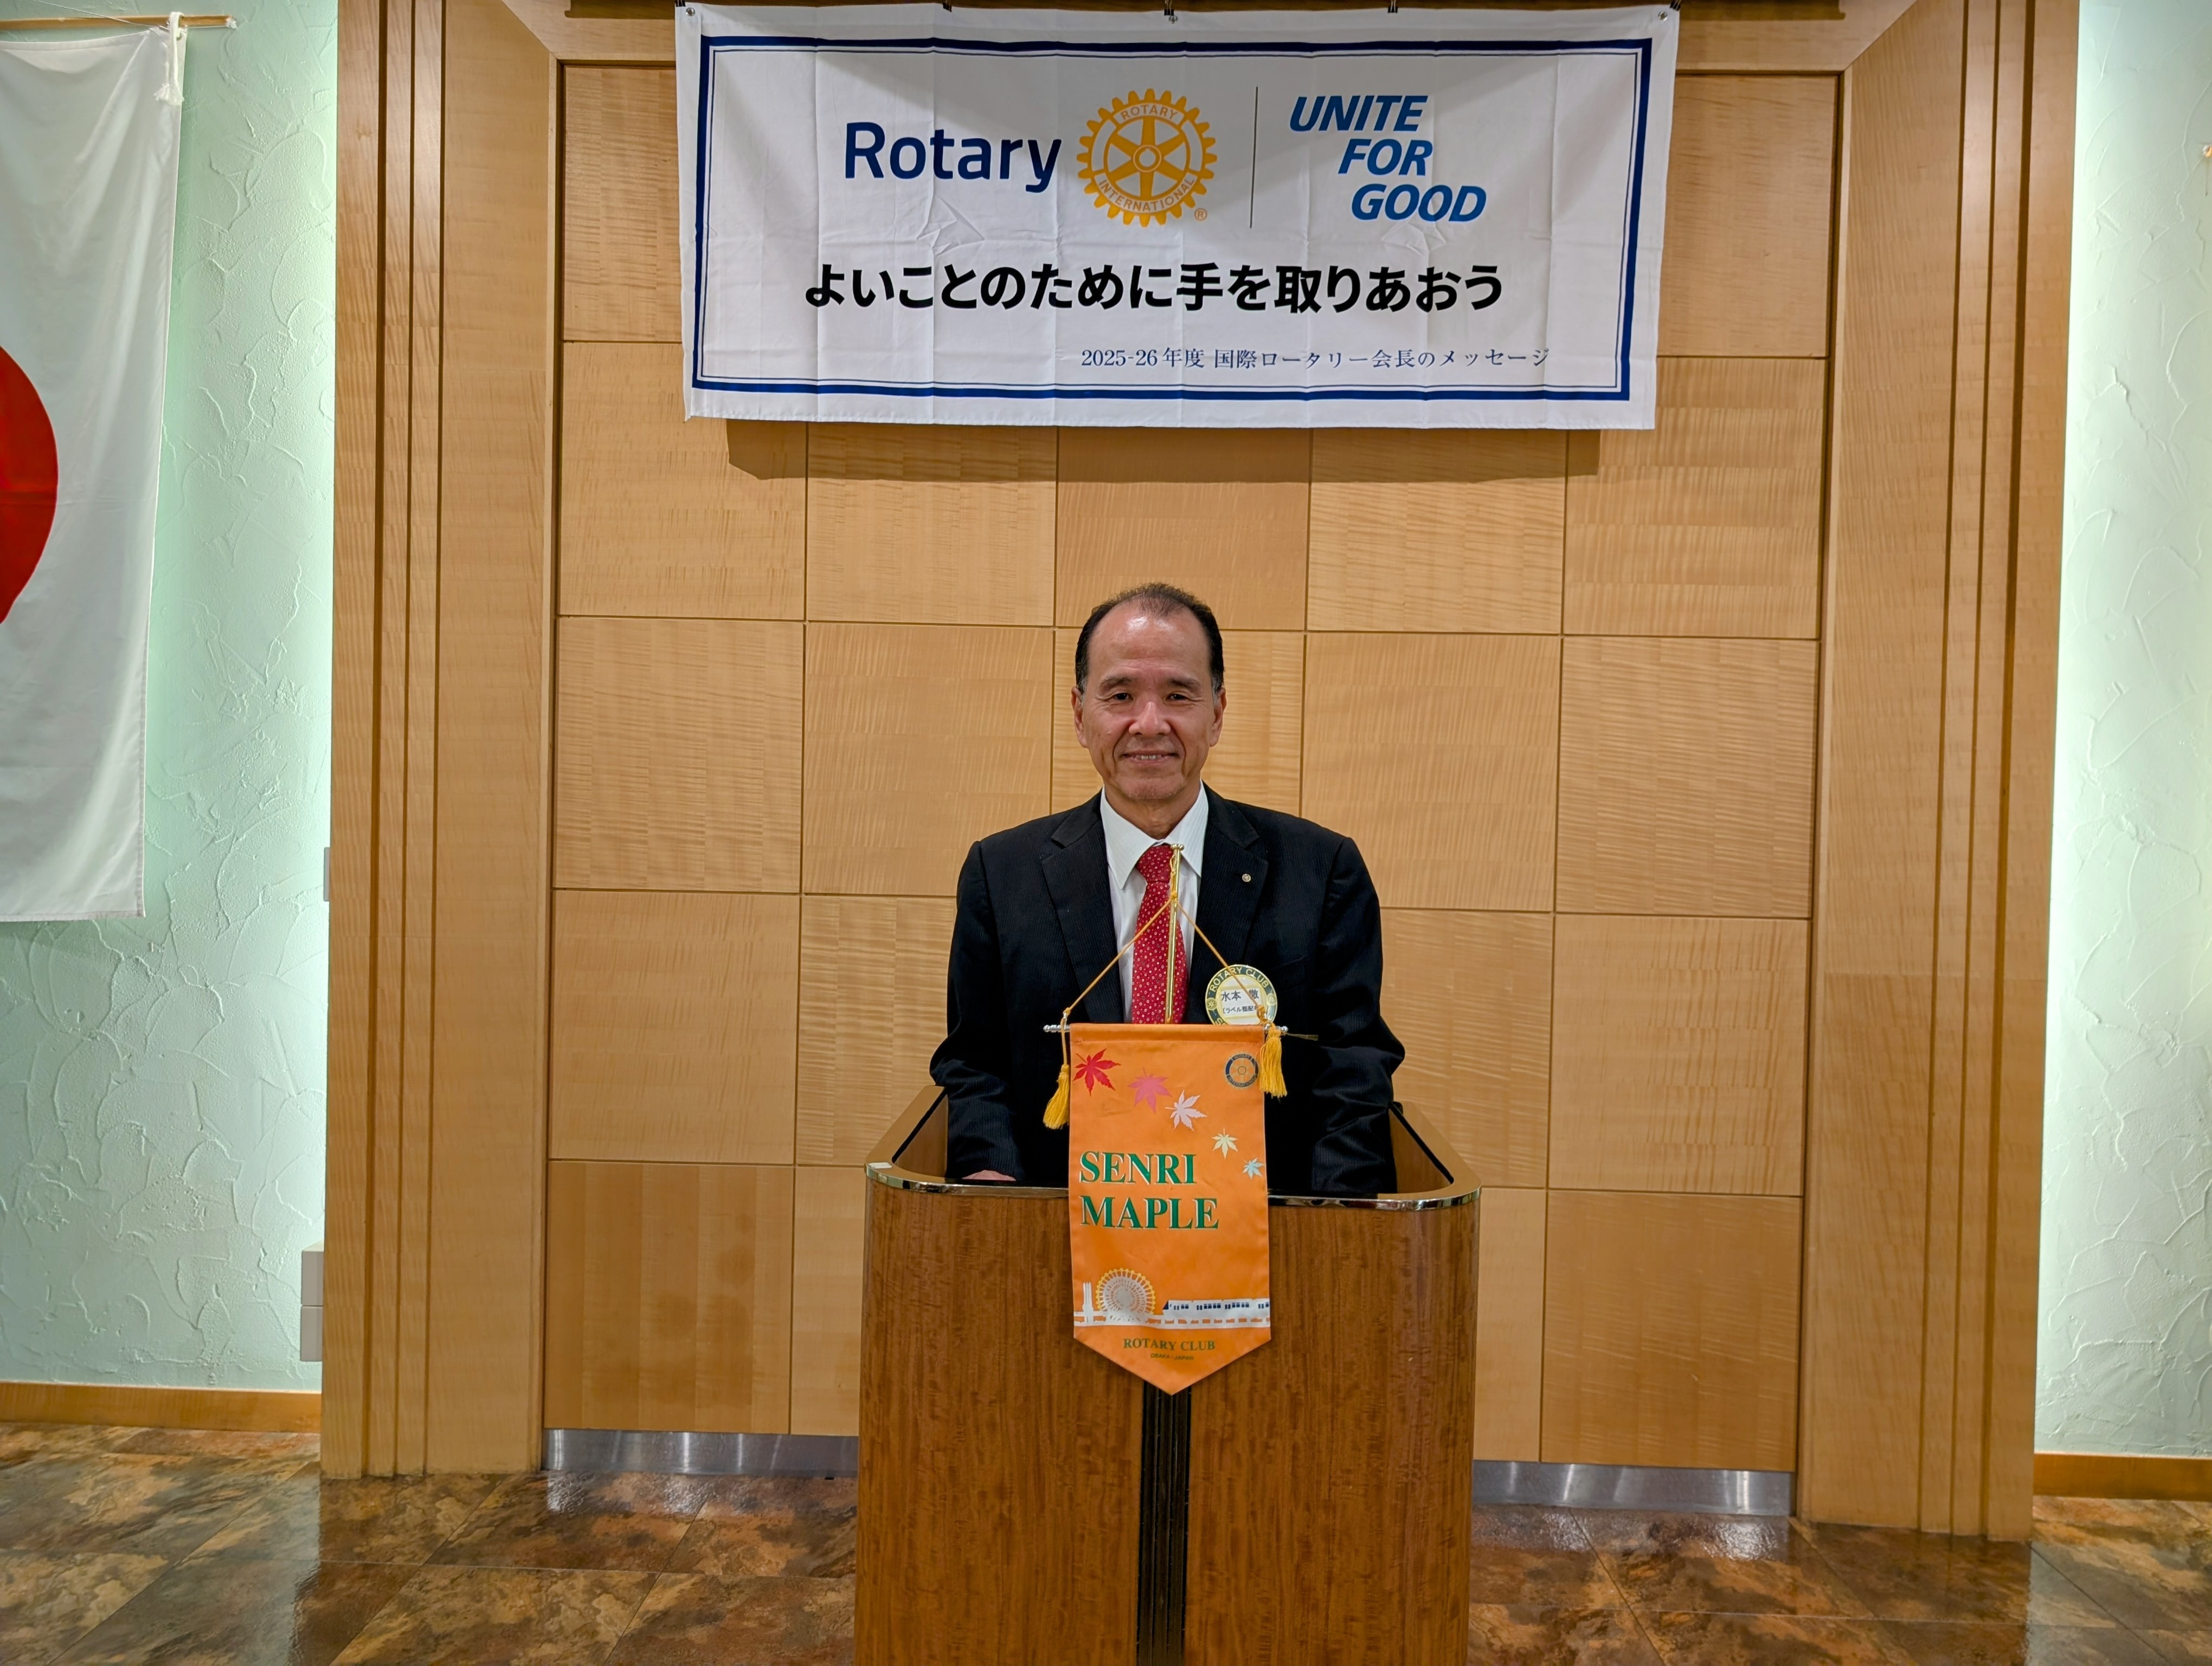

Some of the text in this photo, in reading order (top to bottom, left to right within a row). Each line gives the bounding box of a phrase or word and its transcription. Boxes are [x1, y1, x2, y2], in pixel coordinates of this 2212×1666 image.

[1121, 104, 1178, 120] ROTARY
[1290, 95, 1429, 132] UNITE
[845, 121, 1062, 193] Rotary
[1338, 138, 1433, 176] FOR
[1098, 178, 1195, 212] INTERNATIONAL
[1352, 183, 1487, 222] GOOD
[805, 262, 1502, 313] よいことのために手を取りあおう
[1214, 347, 1549, 369] 国際ロータリー会長のメッセージ
[1210, 967, 1269, 992] ROTARY CLUB
[1079, 1150, 1197, 1186] SENRI
[1079, 1195, 1219, 1229] MAPLE
[1123, 1338, 1216, 1351] ROTARY CLUB
